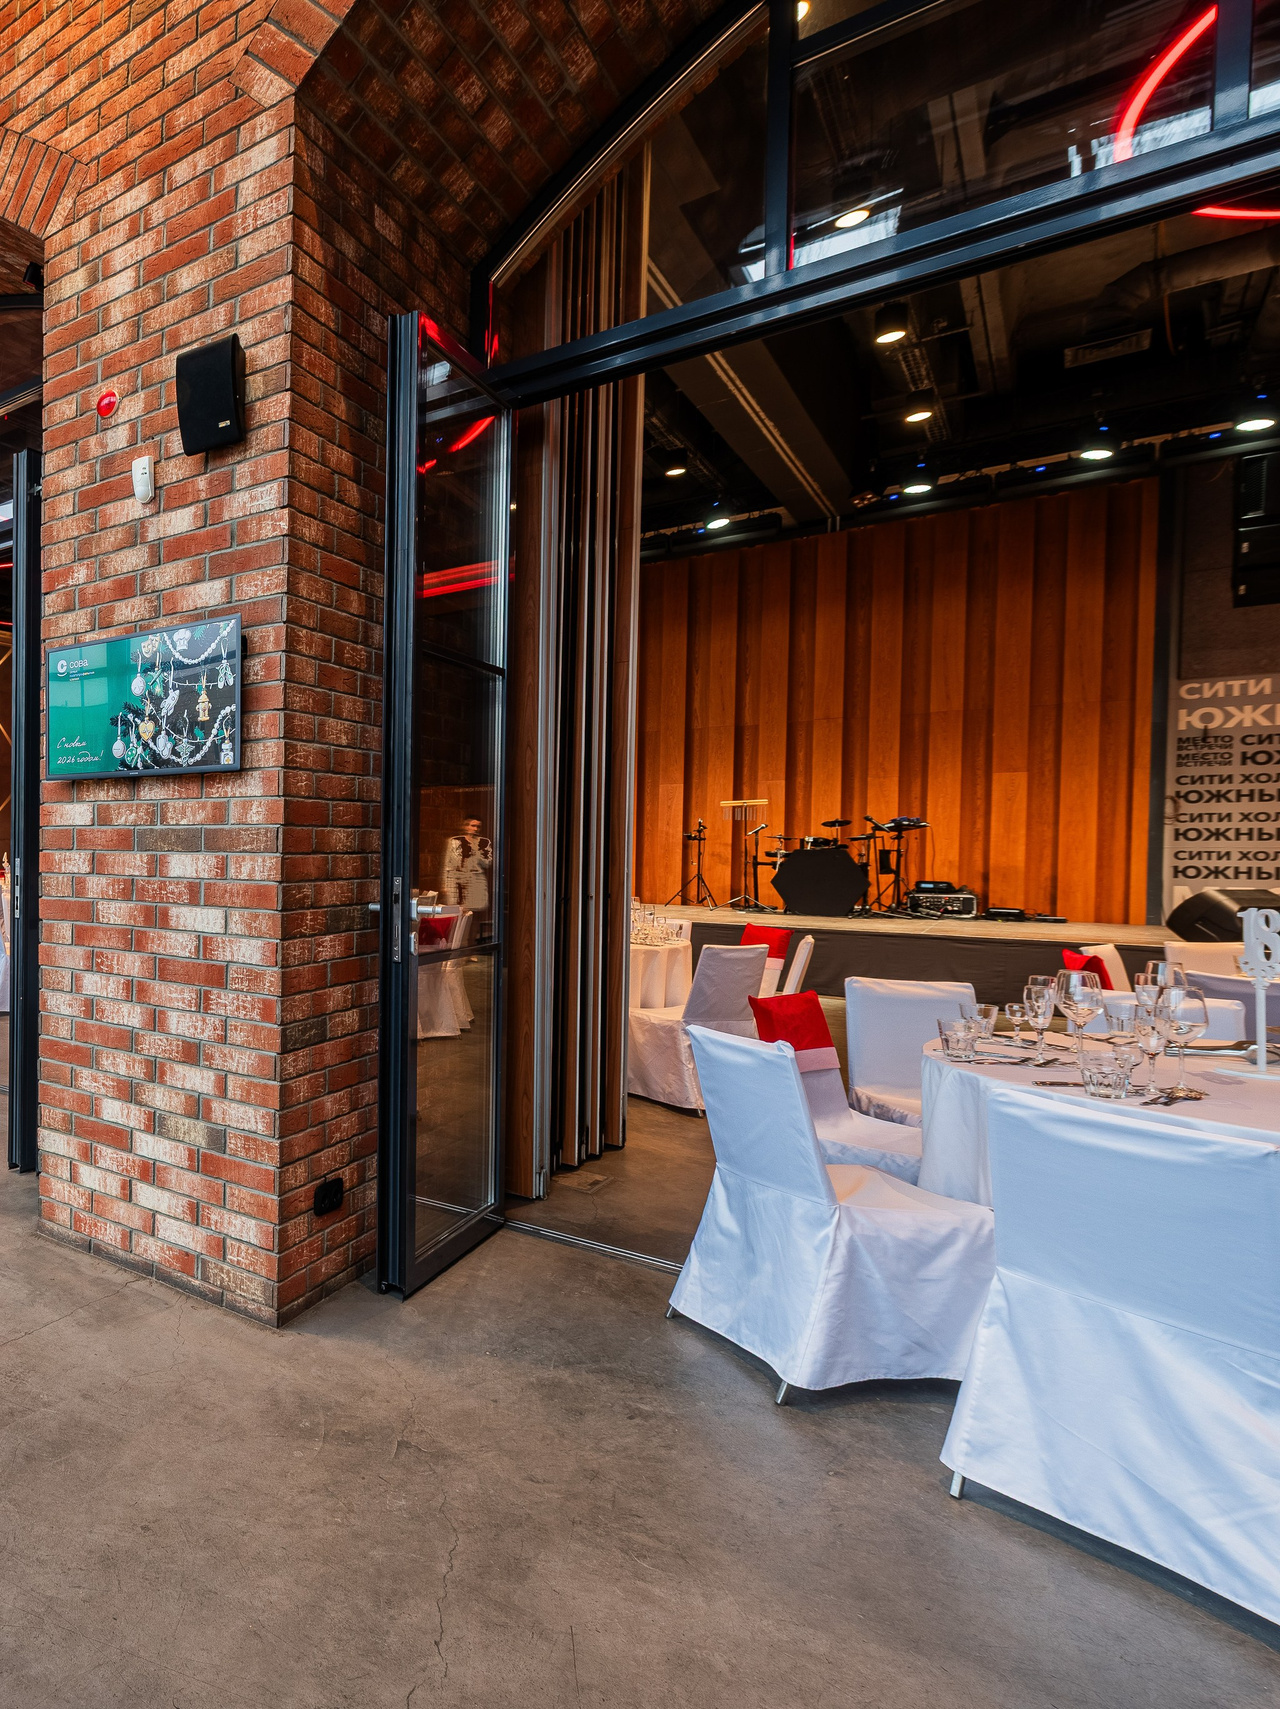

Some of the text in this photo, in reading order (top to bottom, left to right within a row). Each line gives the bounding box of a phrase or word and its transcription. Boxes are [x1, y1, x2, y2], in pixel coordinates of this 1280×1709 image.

[1179, 678, 1273, 700] СИТИ
[1176, 735, 1234, 745] МЕСТО
[1176, 743, 1234, 752] ВСТРЕЧИ
[57, 755, 76, 765] 2026
[1176, 752, 1233, 762] МЕСТО
[1176, 760, 1233, 768] ВСТРЕЧИ
[1175, 774, 1234, 786] СИТИ
[1175, 812, 1233, 823] СИТИ
[1173, 850, 1231, 861] СИТИ
